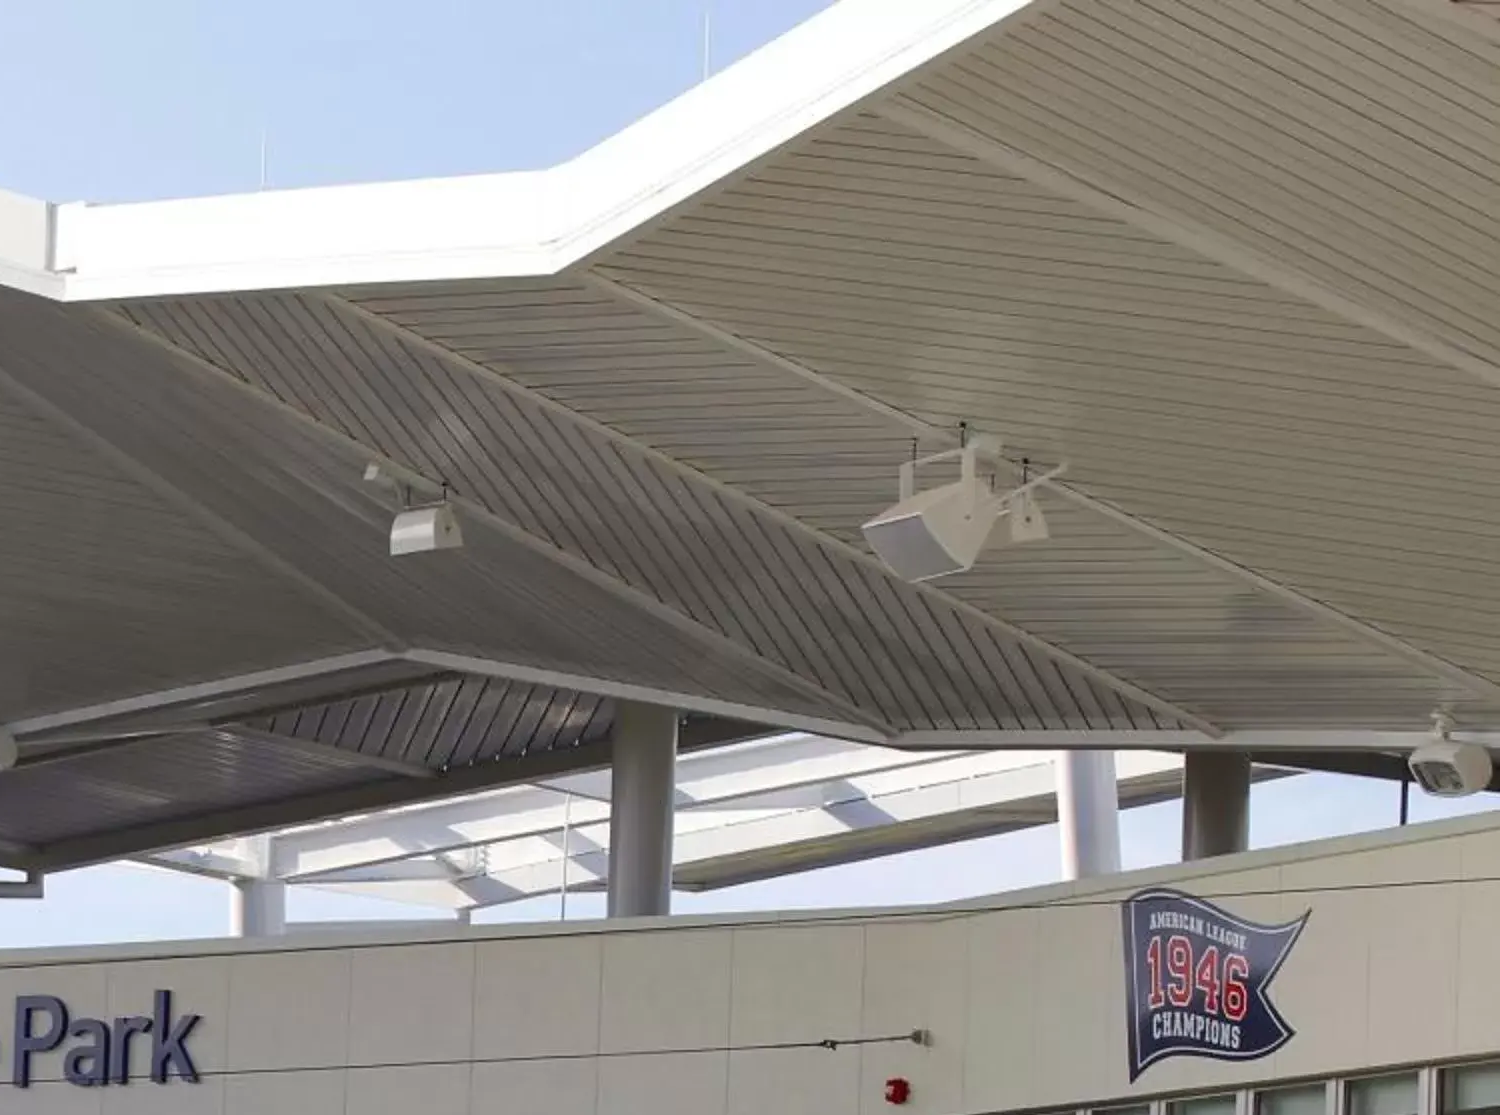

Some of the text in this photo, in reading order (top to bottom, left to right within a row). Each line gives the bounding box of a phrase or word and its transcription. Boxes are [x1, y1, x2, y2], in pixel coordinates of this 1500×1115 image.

[1150, 911, 1247, 951] AMERICAN LEAGUE
[1146, 934, 1249, 1022] 1946
[14, 989, 203, 1089] Park
[1152, 1010, 1242, 1050] CHAMPIONS
